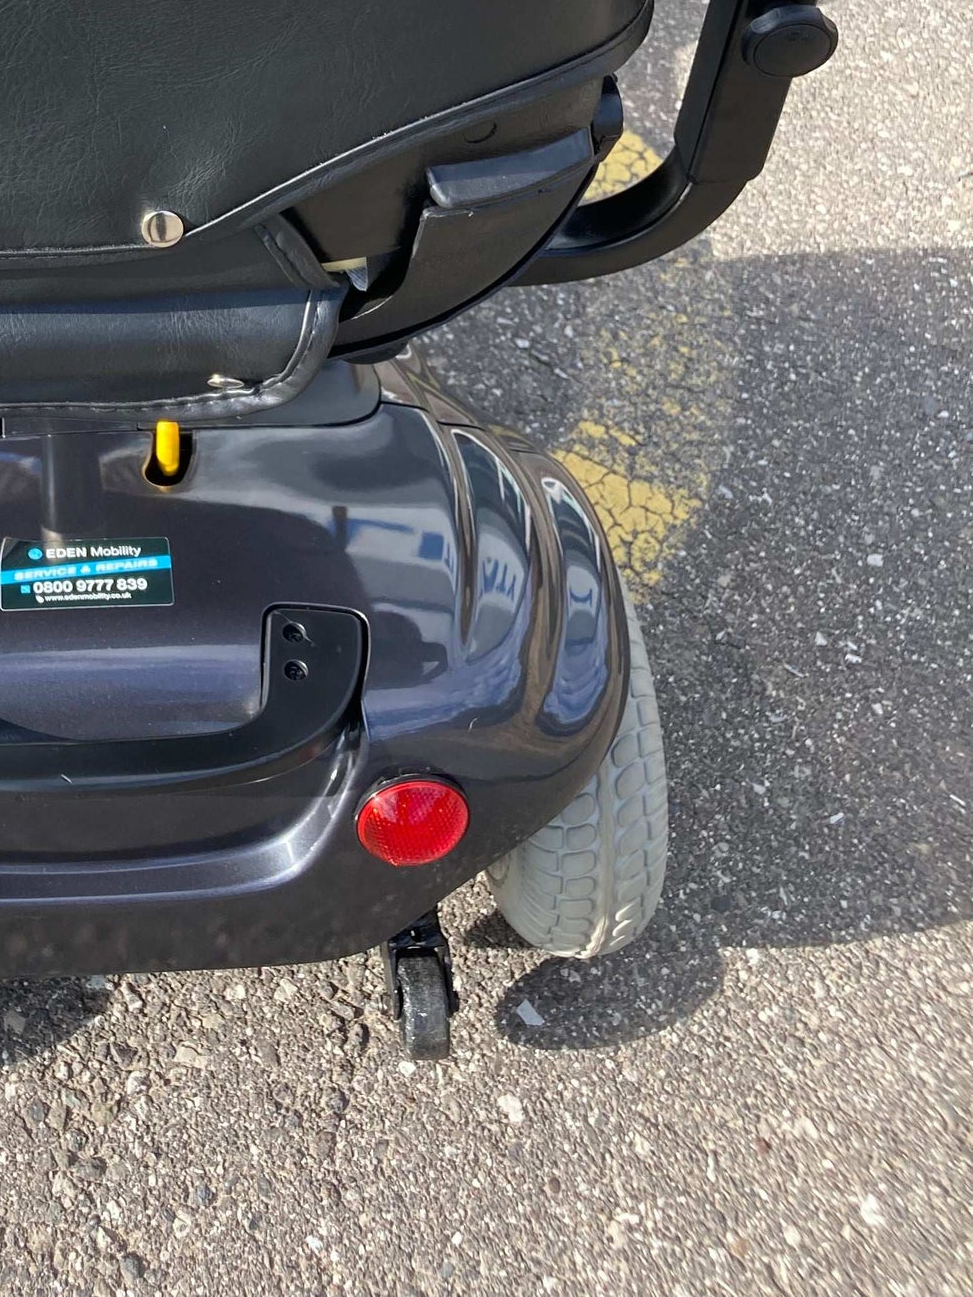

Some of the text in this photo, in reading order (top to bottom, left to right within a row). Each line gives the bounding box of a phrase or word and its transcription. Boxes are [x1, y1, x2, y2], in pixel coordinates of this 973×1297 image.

[46, 545, 142, 559] EDEN Mobility
[14, 558, 158, 581] SERVICE & REPAIRS
[33, 577, 148, 594] 0800 9777 839
[44, 591, 132, 602] www.edenmobility.co.uk
